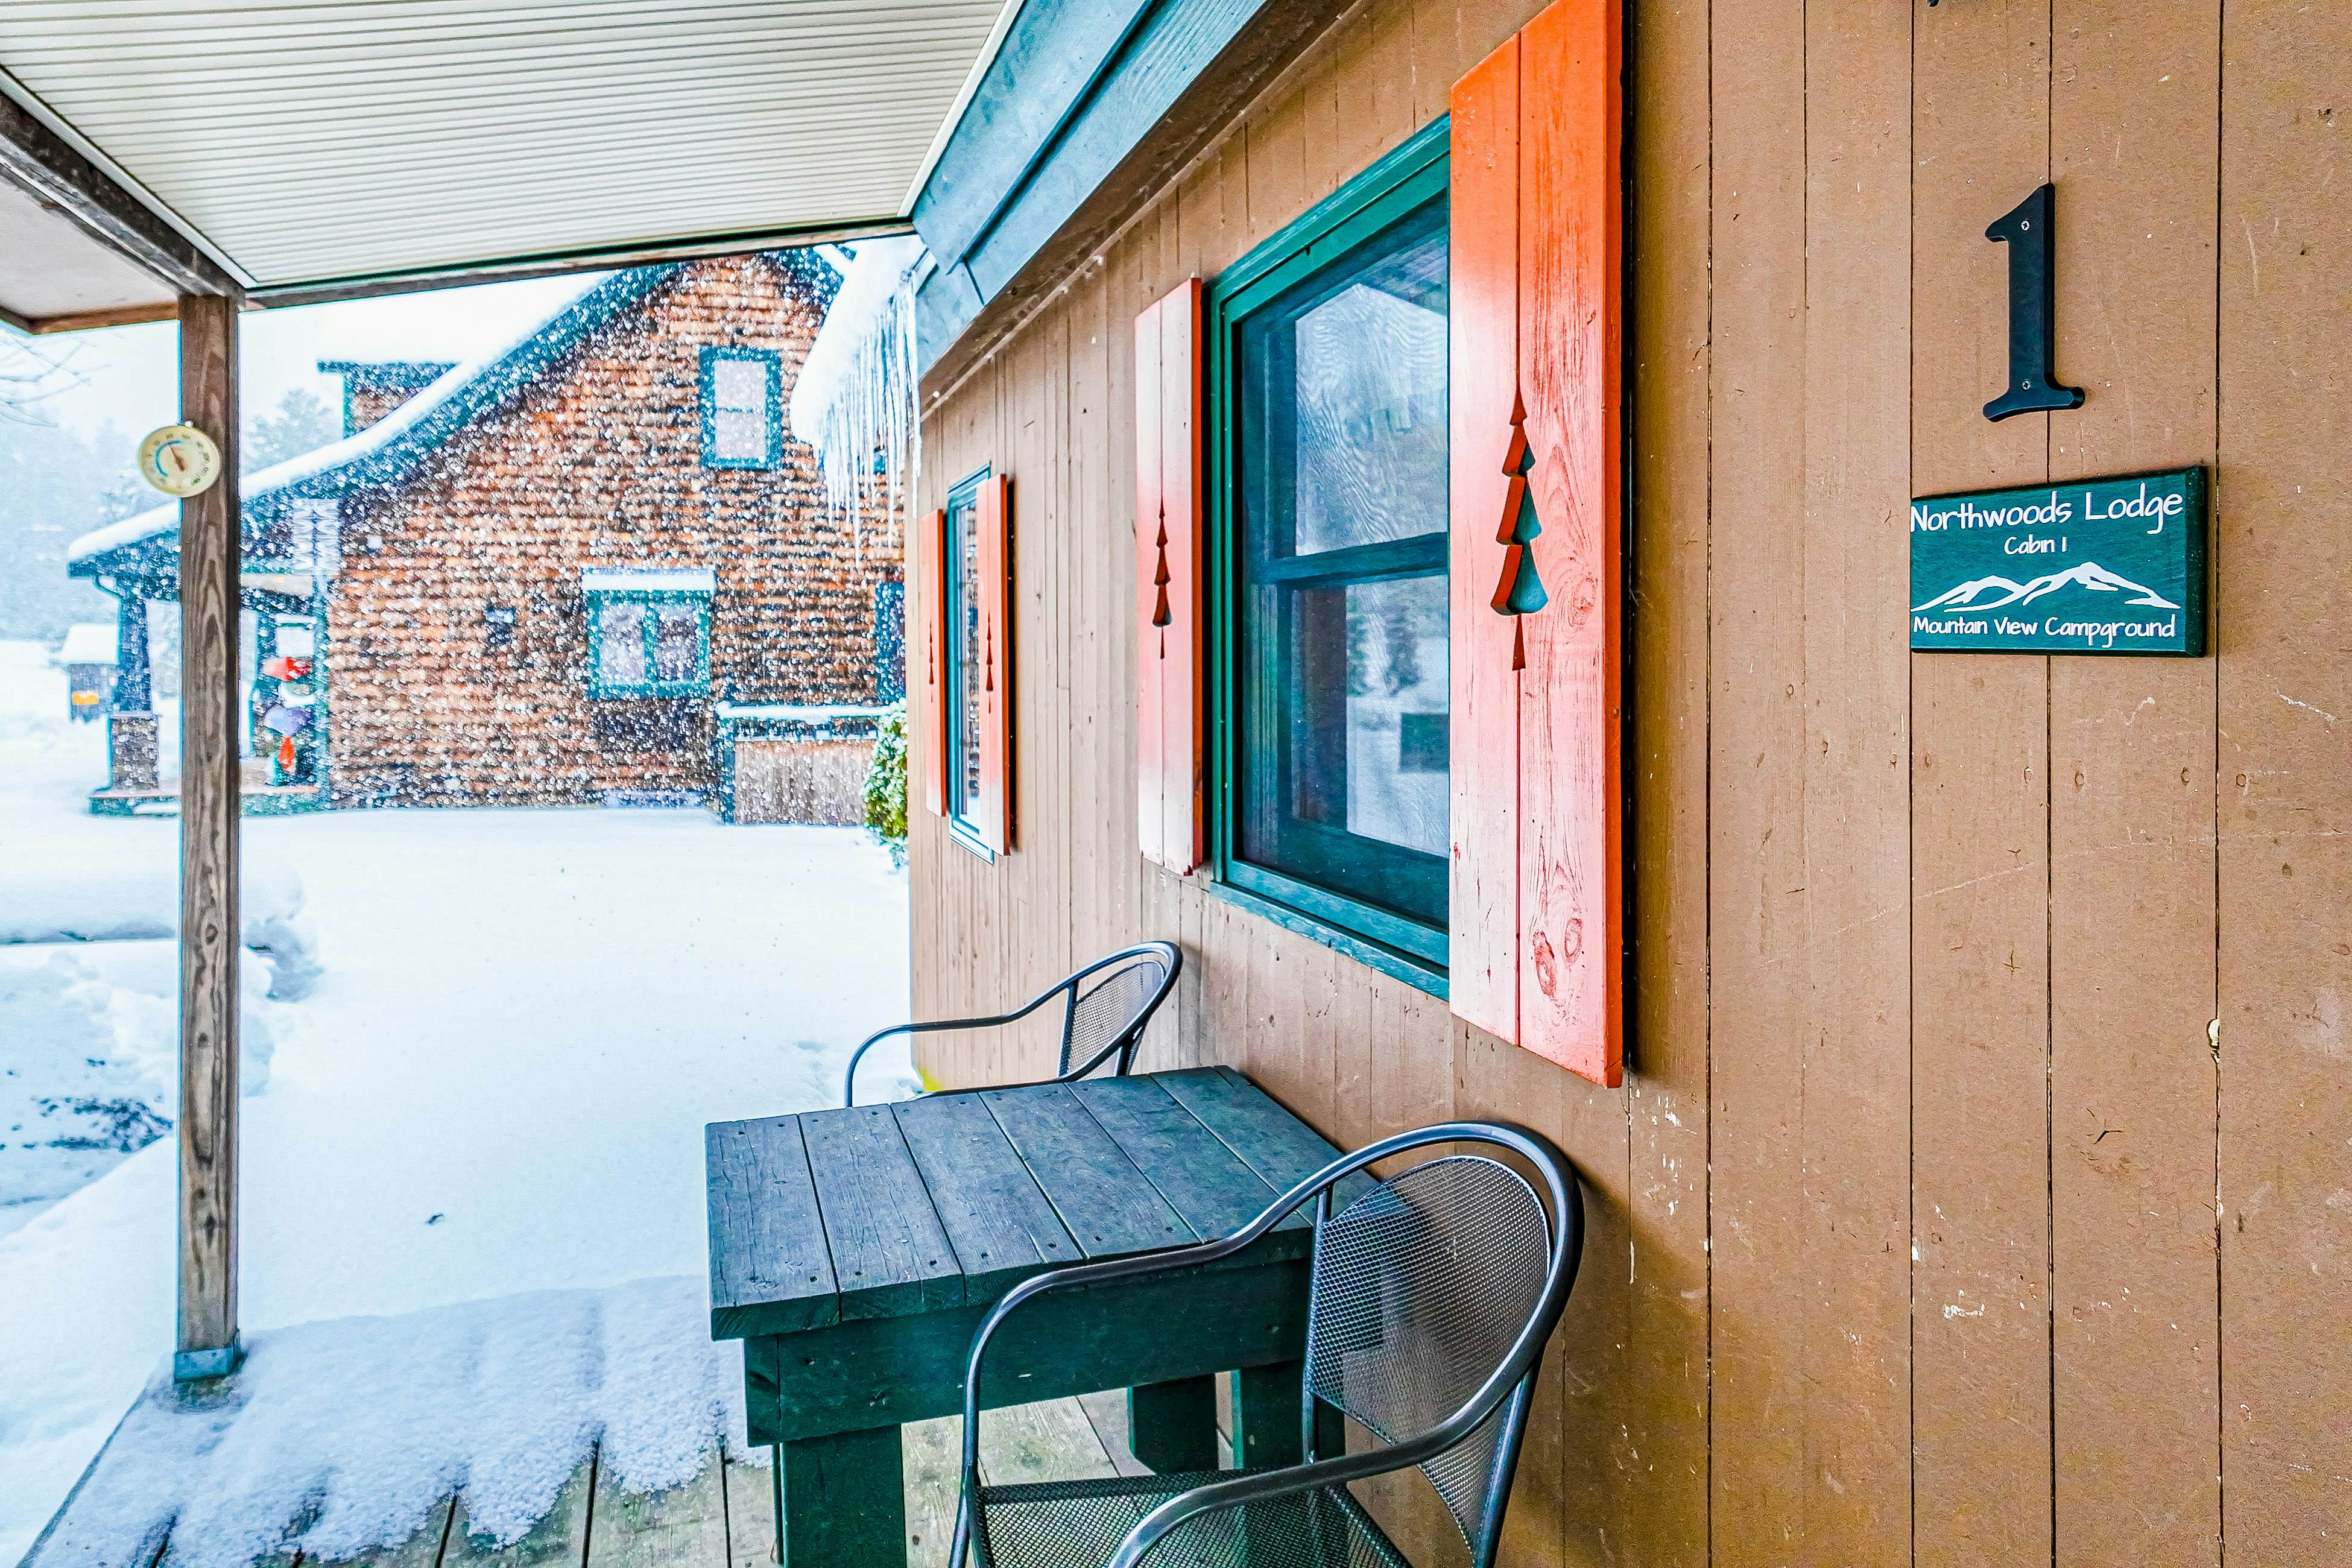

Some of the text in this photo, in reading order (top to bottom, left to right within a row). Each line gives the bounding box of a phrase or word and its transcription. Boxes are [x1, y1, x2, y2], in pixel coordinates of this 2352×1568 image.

[1982, 182, 2085, 422] 1
[1910, 482, 2183, 535] Northwoods Lodge
[2003, 534, 2056, 555] Cabin
[1913, 613, 2176, 648] Mountain View Campground
